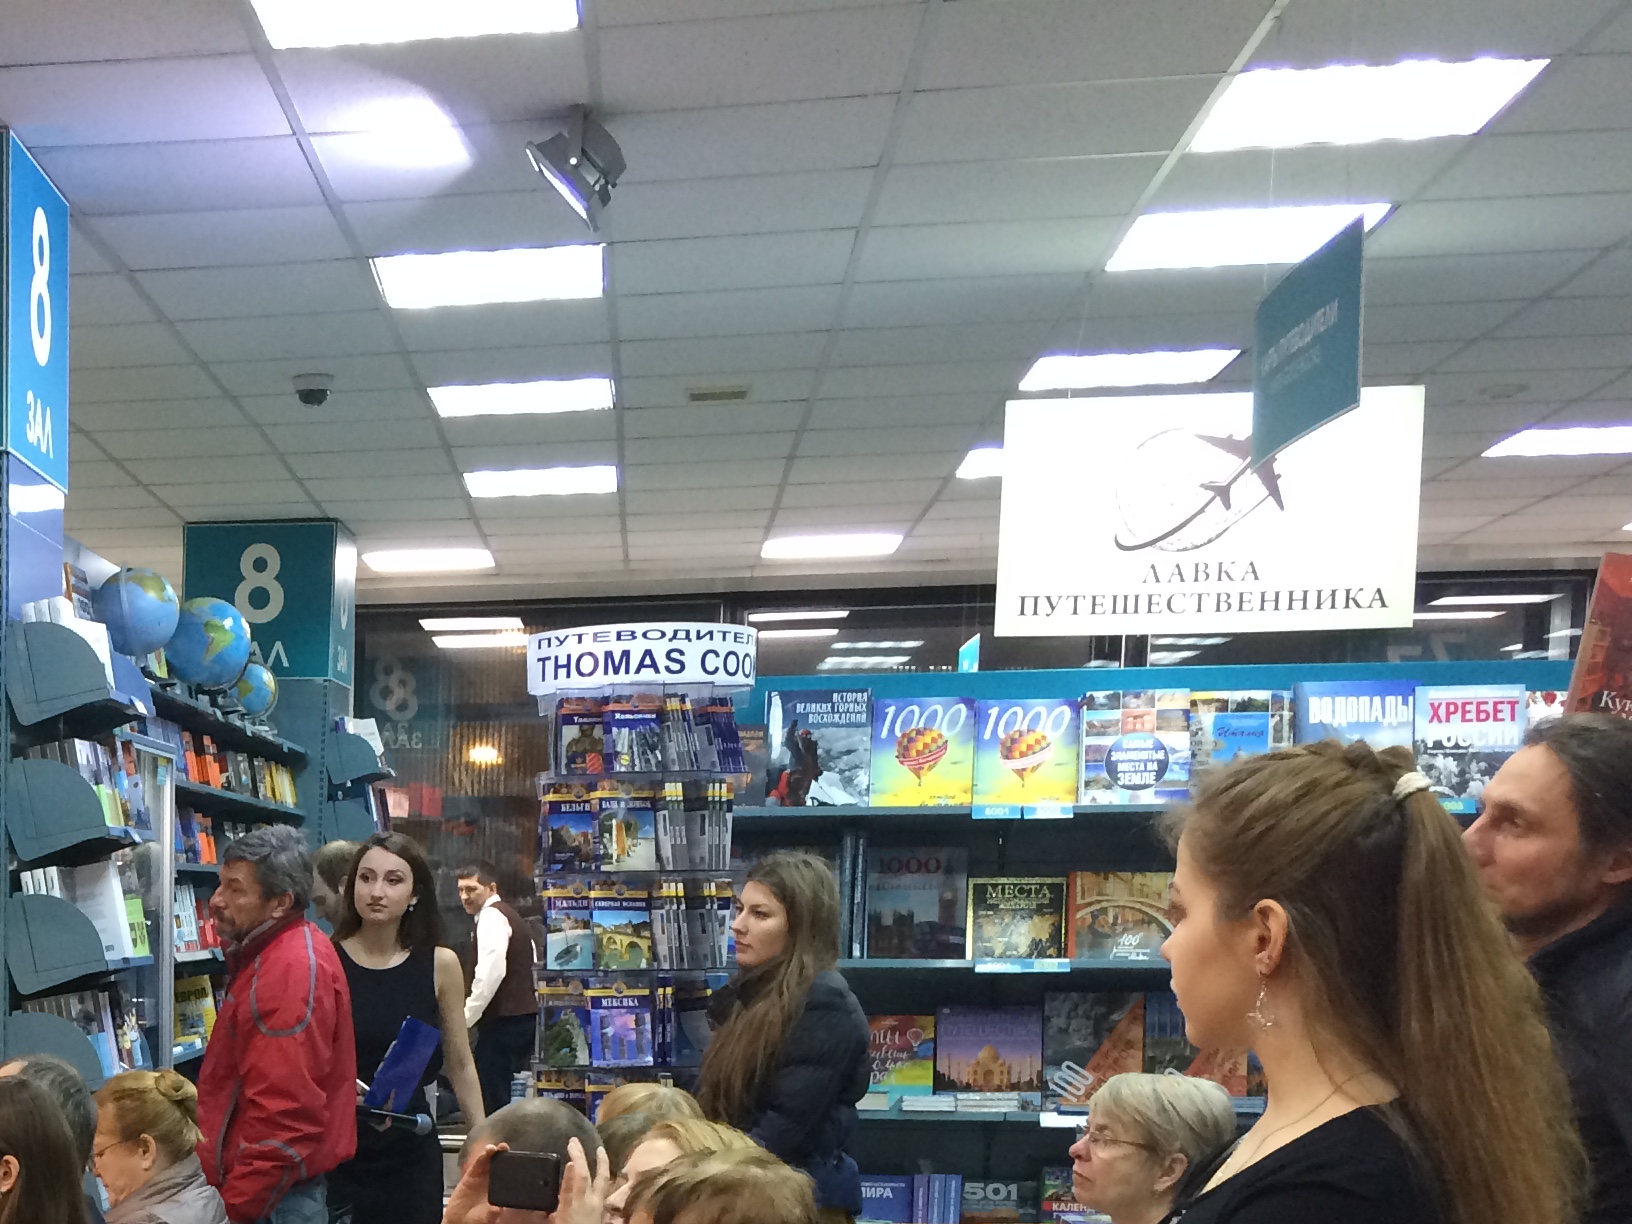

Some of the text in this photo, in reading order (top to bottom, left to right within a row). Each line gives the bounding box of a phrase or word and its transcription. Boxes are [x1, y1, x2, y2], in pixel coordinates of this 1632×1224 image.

[30, 206, 51, 366] 8
[26, 389, 53, 459] ЗАЛ
[234, 543, 285, 624] 8
[1142, 561, 1260, 584] ЛАВКА
[1018, 587, 1389, 617] ПУТЕШЕСТВЕННИКА
[537, 648, 686, 682] THOMAS
[796, 702, 868, 714] ВЕЛИКИХ ГОРНЫХ
[832, 692, 868, 703] ИСТОРИЯ
[881, 704, 967, 740] 1000
[1308, 694, 1414, 727] ВОДОПАДЫ
[1428, 700, 1520, 723] ХРЕБЕТ
[984, 704, 1070, 741] 1000
[1216, 724, 1265, 739] Италия
[1427, 724, 1520, 748] РОССИИ
[1110, 749, 1165, 761] ЗНАМЕНИТЫЕ
[1117, 761, 1159, 772] МЕСТА НА
[1117, 771, 1157, 786] ЗЕМЛЕ
[879, 856, 942, 874] 1000
[986, 884, 1050, 899] МЕСТА
[601, 997, 639, 1007] МЕКСИКА
[1048, 1060, 1094, 1103] 100
[964, 1182, 1018, 1200] 501
